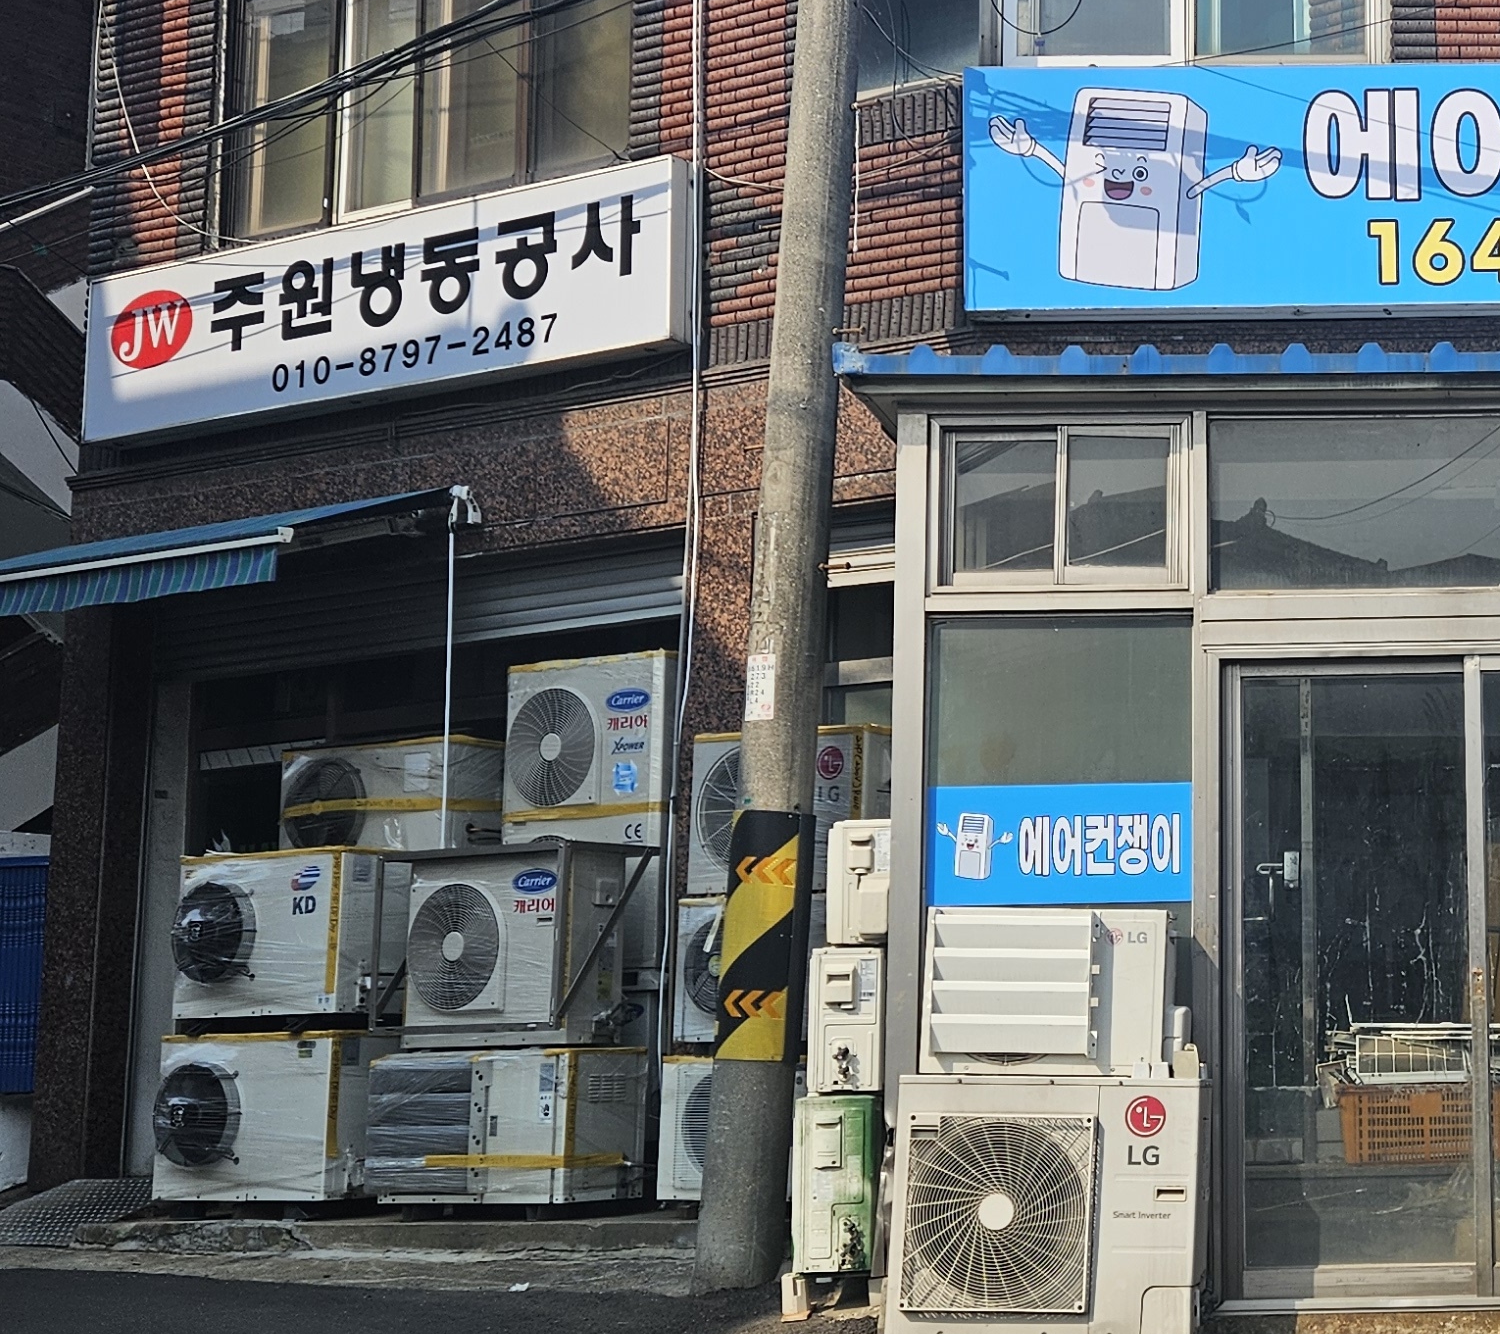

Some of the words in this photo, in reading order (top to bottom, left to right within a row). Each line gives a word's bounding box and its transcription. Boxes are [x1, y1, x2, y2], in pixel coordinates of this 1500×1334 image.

[208, 194, 642, 352] 주원냉동공사
[119, 299, 183, 364] JW
[271, 313, 558, 393] 010-8797-2487
[610, 693, 645, 707] Carrier
[606, 714, 648, 732] 캐리어
[817, 785, 840, 803] LG
[624, 822, 643, 839] CE
[1017, 812, 1182, 878] 에어컨쟁이
[517, 874, 553, 888] Carrier
[291, 895, 317, 916] KD
[513, 897, 555, 914] 캐리어
[1126, 931, 1149, 945] LG
[1127, 1144, 1161, 1167] LG
[1112, 1210, 1136, 1220] Smart
[1138, 1210, 1172, 1220] Inverter
